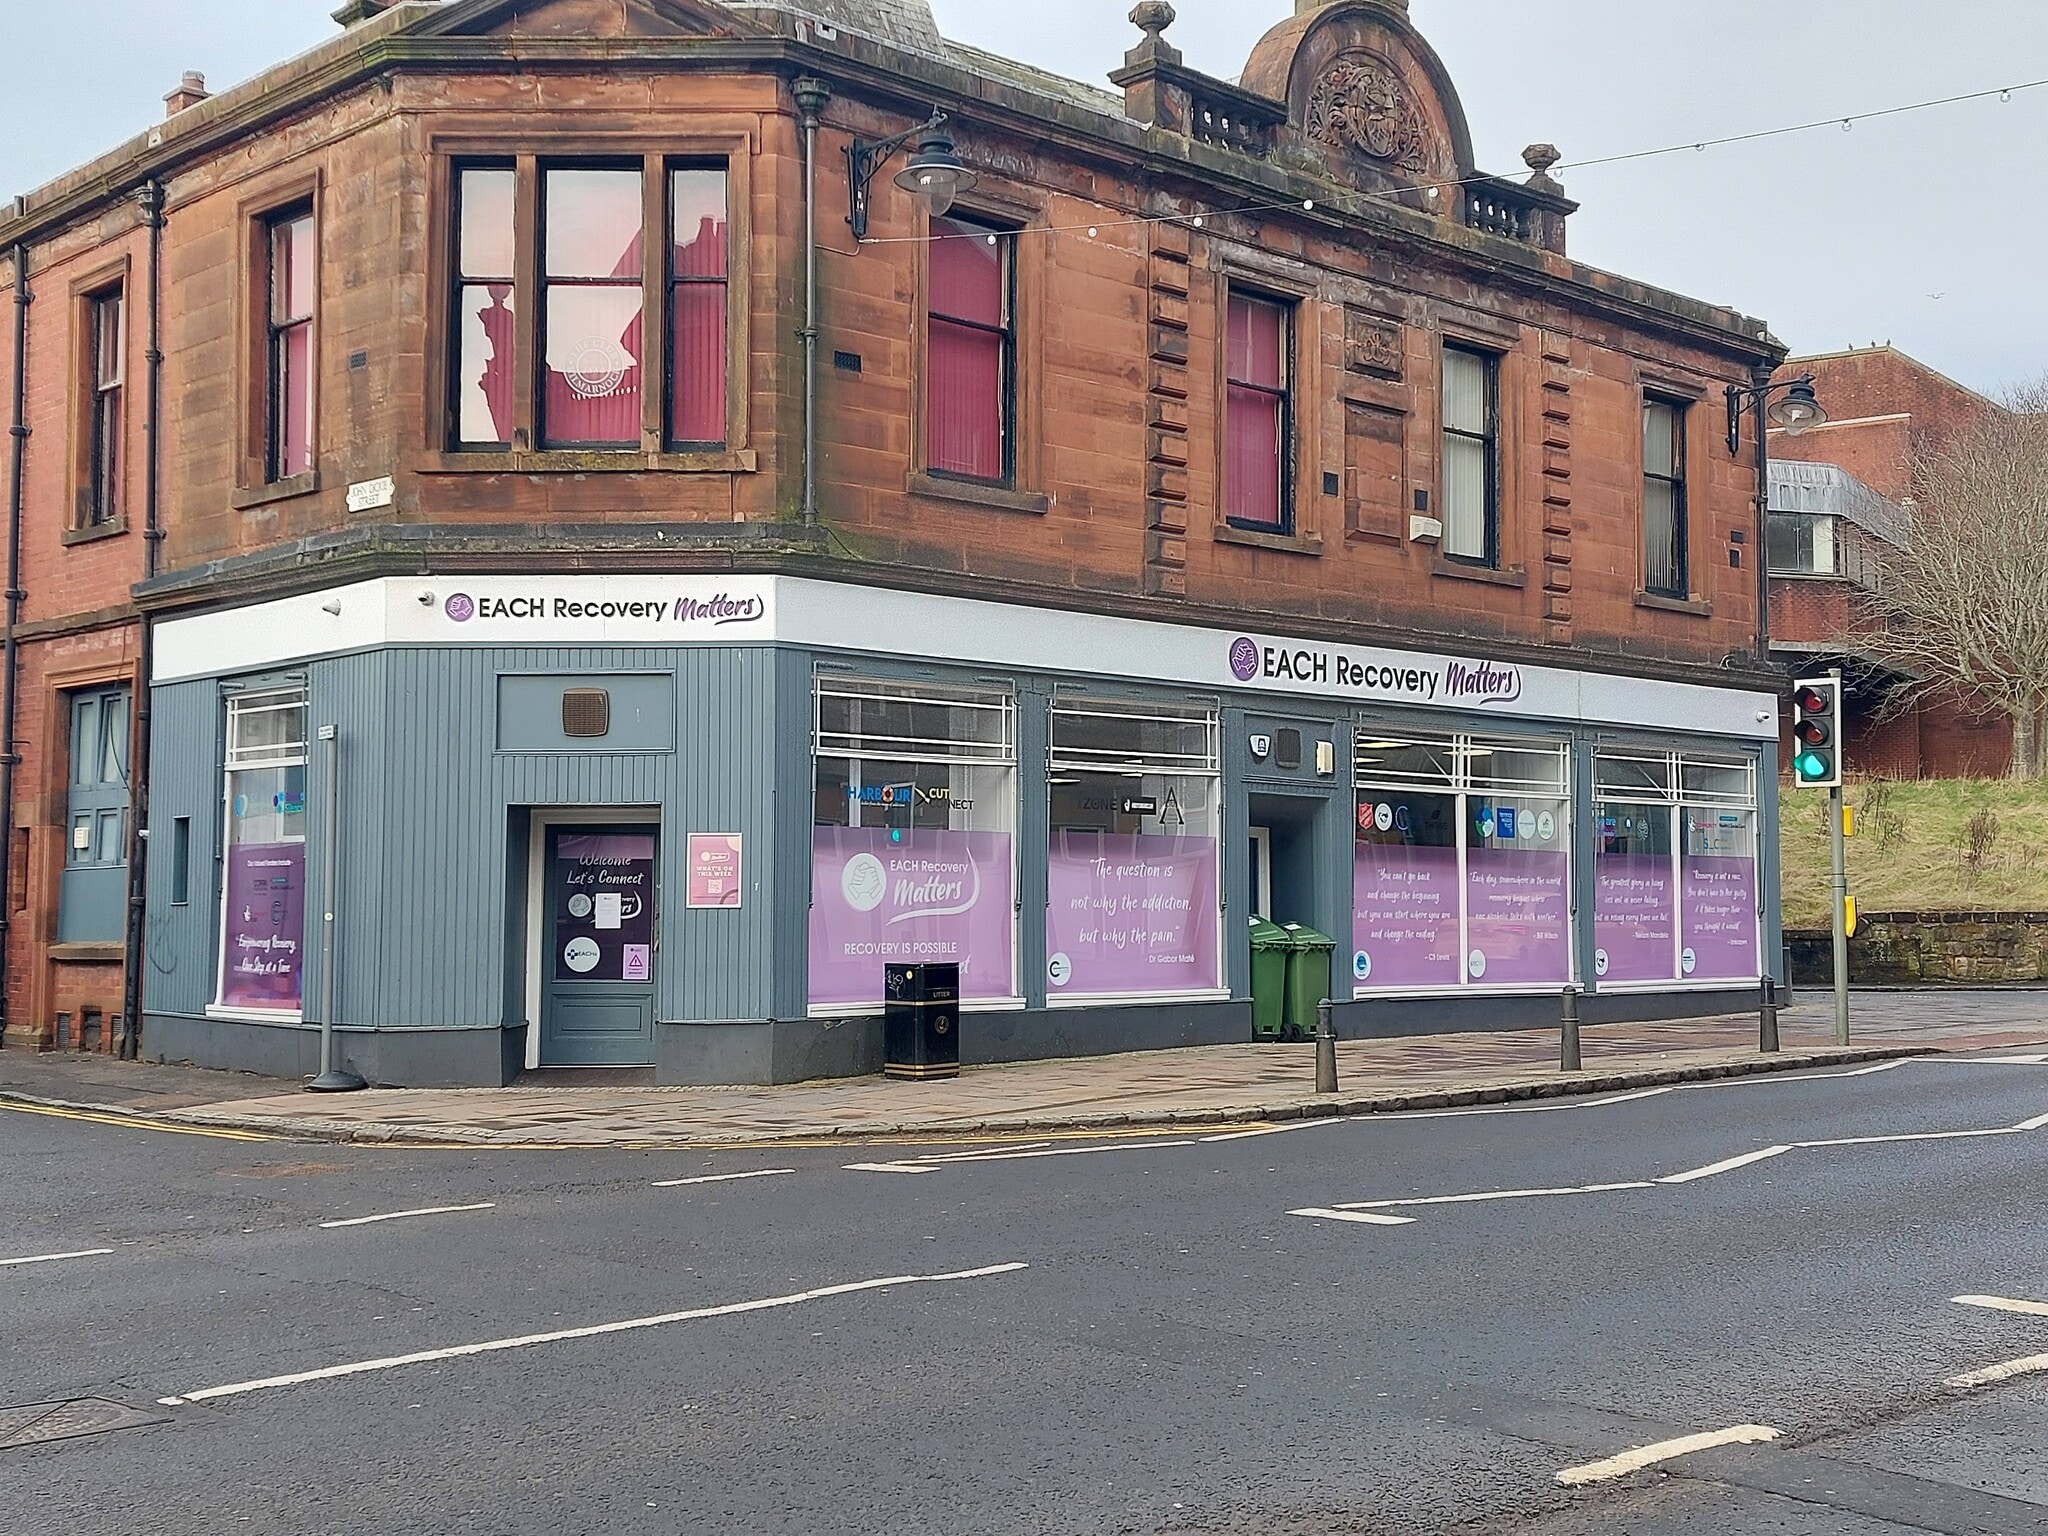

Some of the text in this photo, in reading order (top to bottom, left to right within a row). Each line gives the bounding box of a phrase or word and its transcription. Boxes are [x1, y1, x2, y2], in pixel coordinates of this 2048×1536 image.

[479, 594, 758, 623] EACH Recovery Matters
[1263, 647, 1516, 700] EACH Recovery Matters
[580, 852, 631, 866] Welcome
[890, 860, 968, 875] EACH Recovery
[1116, 862, 1160, 881] question
[1164, 865, 1173, 877] is
[566, 870, 644, 885] Let's Connect
[1407, 872, 1415, 884] go
[1417, 872, 1430, 880] back
[894, 875, 962, 906] Matters
[1367, 890, 1379, 900] and
[1381, 891, 1400, 903] change
[1401, 891, 1410, 900] the
[1071, 893, 1191, 916] not why the addiction,
[1357, 910, 1368, 918] but
[1370, 912, 1381, 922] you
[1395, 910, 1409, 919] start
[1410, 911, 1427, 920] where
[1429, 912, 1439, 923] you
[1079, 928, 1099, 943] but
[1102, 928, 1126, 949] why
[1131, 927, 1147, 944] the
[1371, 929, 1383, 939] and
[1384, 929, 1403, 942] change
[1405, 929, 1414, 939] the
[844, 942, 957, 955] RECOVERY IS POSSIBLE
[1157, 955, 1177, 963] Gabor
